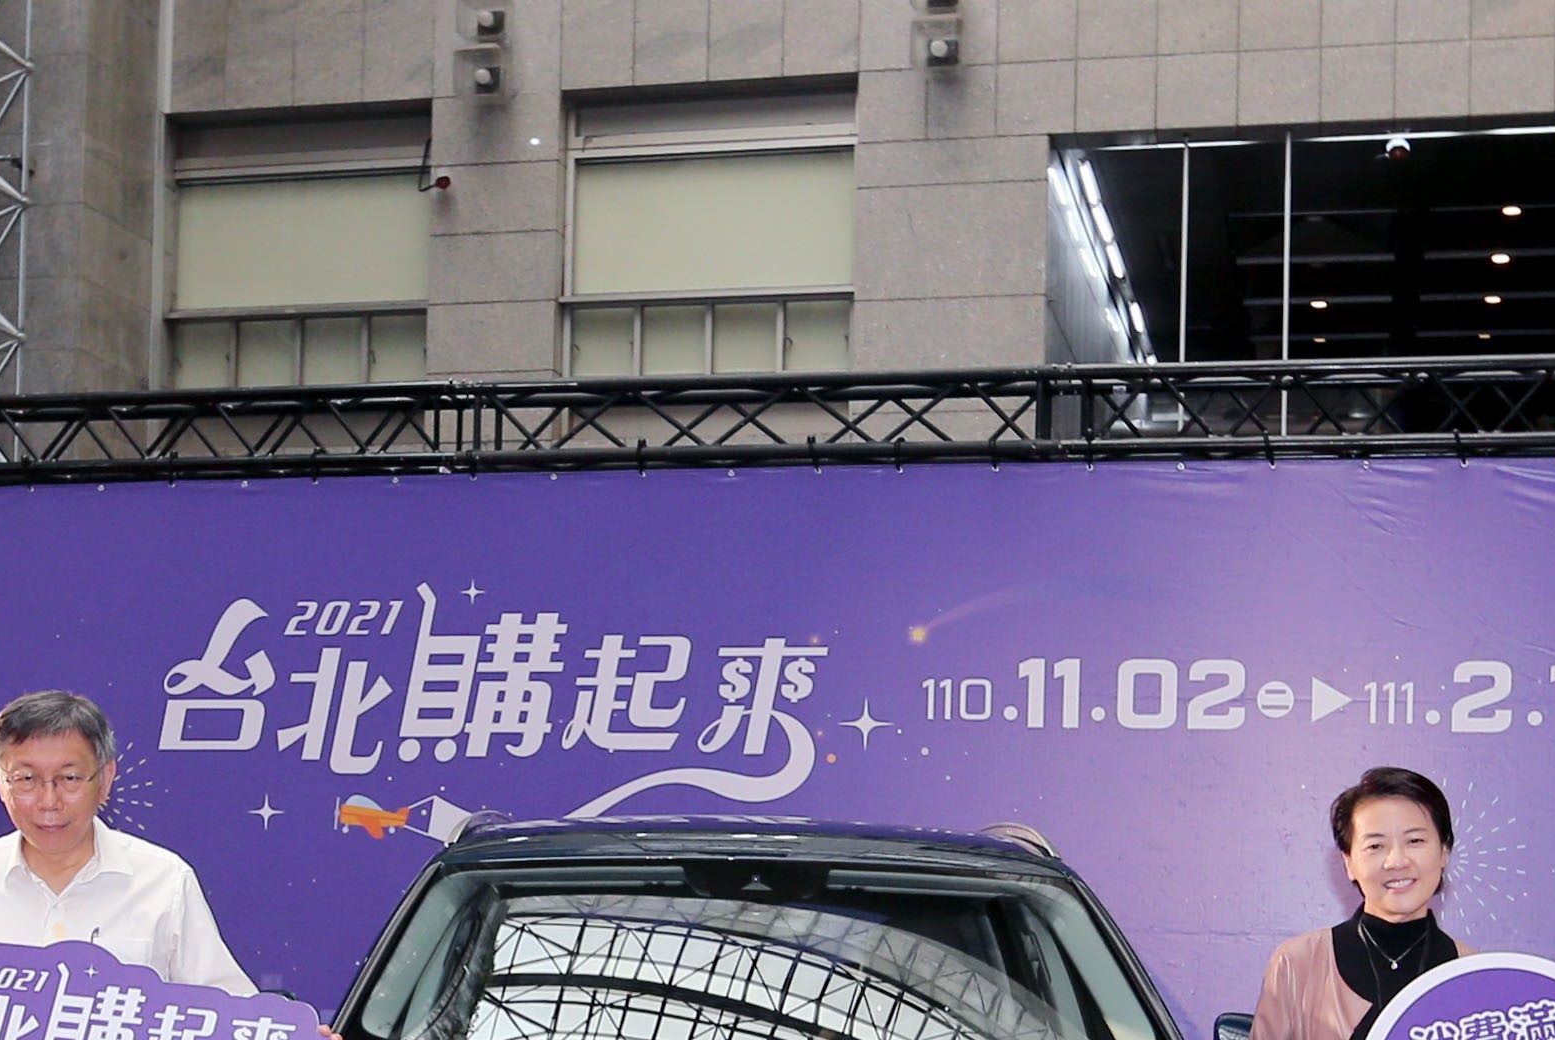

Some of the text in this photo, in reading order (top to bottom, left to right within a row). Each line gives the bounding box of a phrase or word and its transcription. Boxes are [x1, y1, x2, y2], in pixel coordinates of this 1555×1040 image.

[284, 600, 403, 637] 2021
[157, 583, 830, 785] 台北購起來
